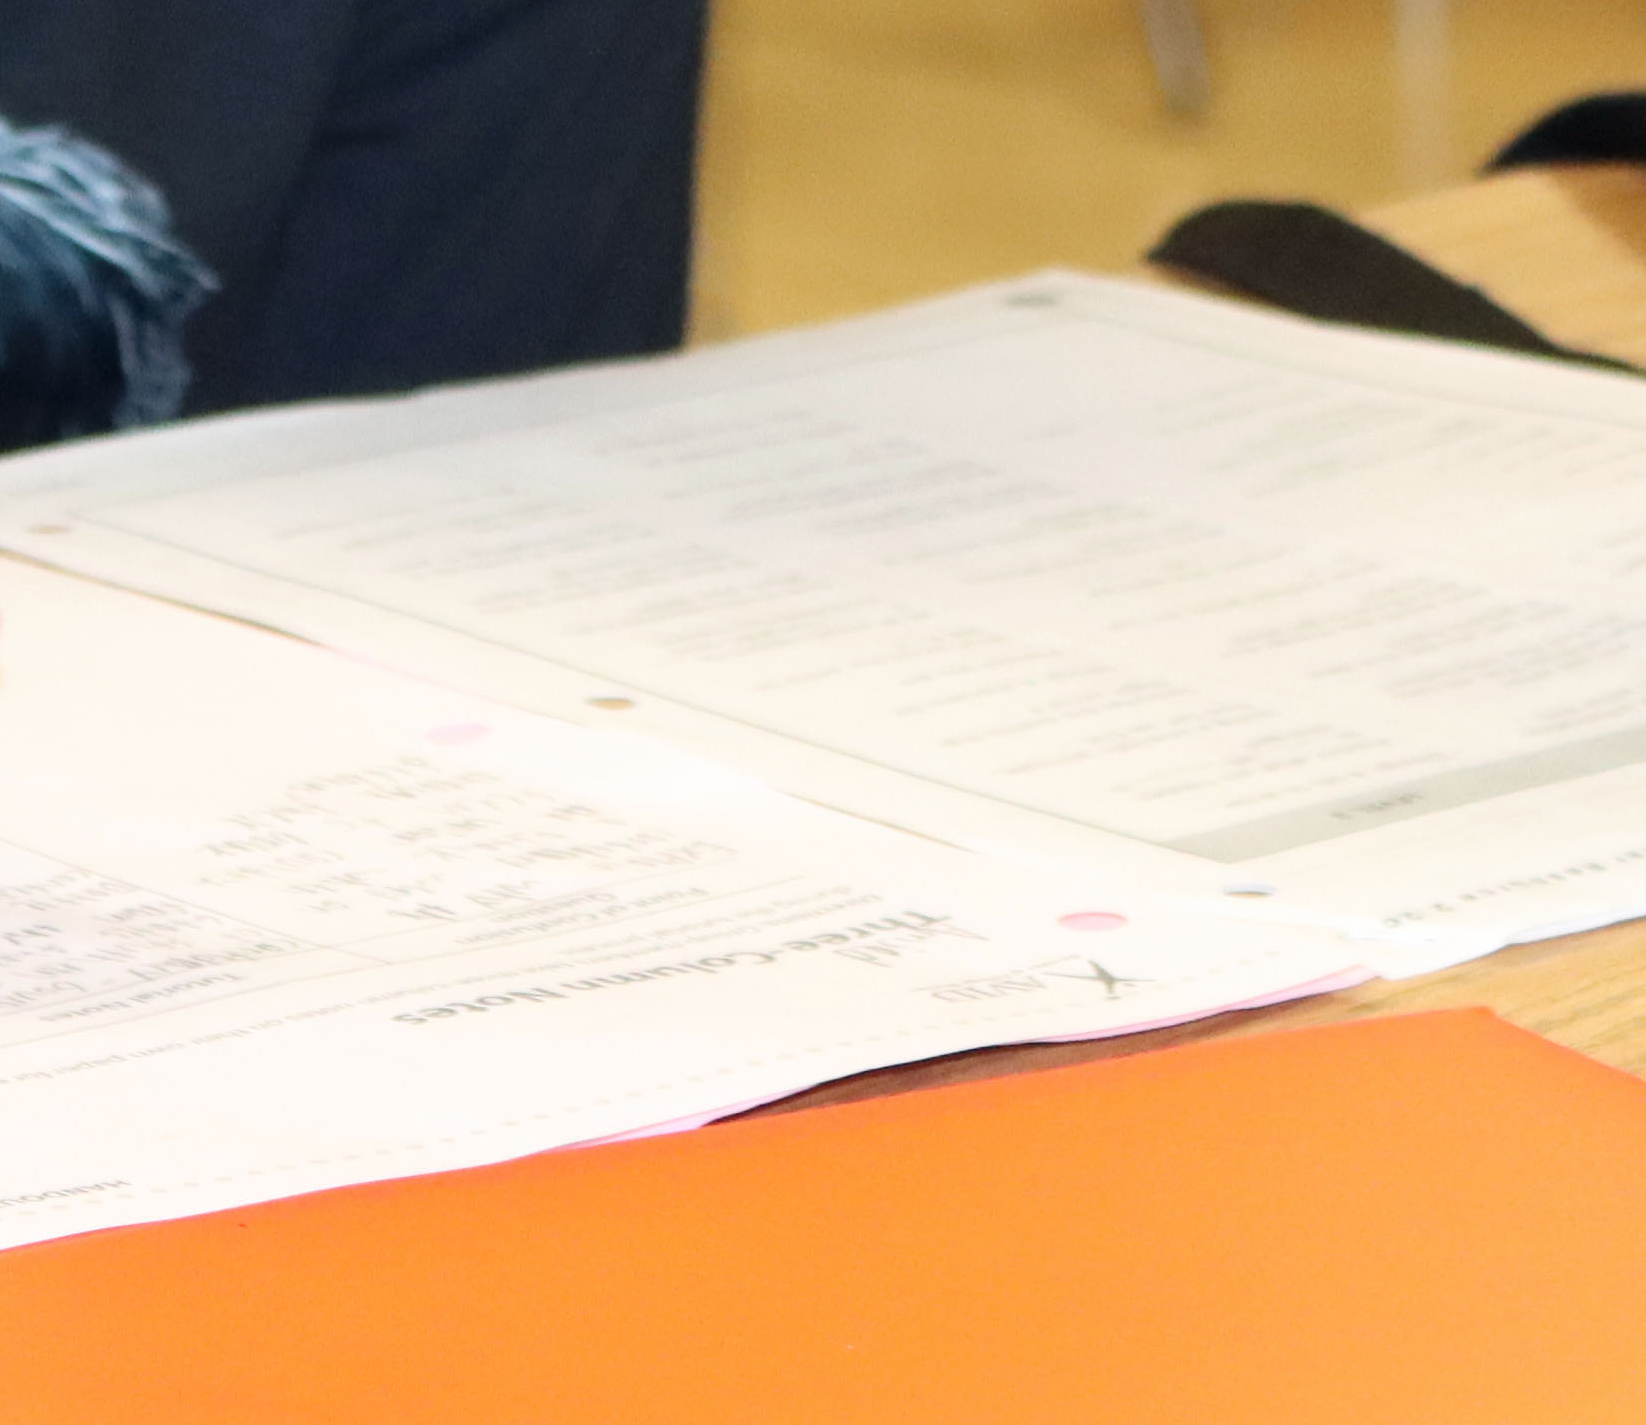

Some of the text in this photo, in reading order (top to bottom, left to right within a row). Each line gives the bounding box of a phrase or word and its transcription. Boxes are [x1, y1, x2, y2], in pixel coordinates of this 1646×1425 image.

[558, 911, 951, 993] Three-Column
[39, 973, 240, 1022] Tutorial Notes
[386, 987, 568, 1026] Notes
[47, 1054, 132, 1074] paper
[122, 1042, 191, 1058] own
